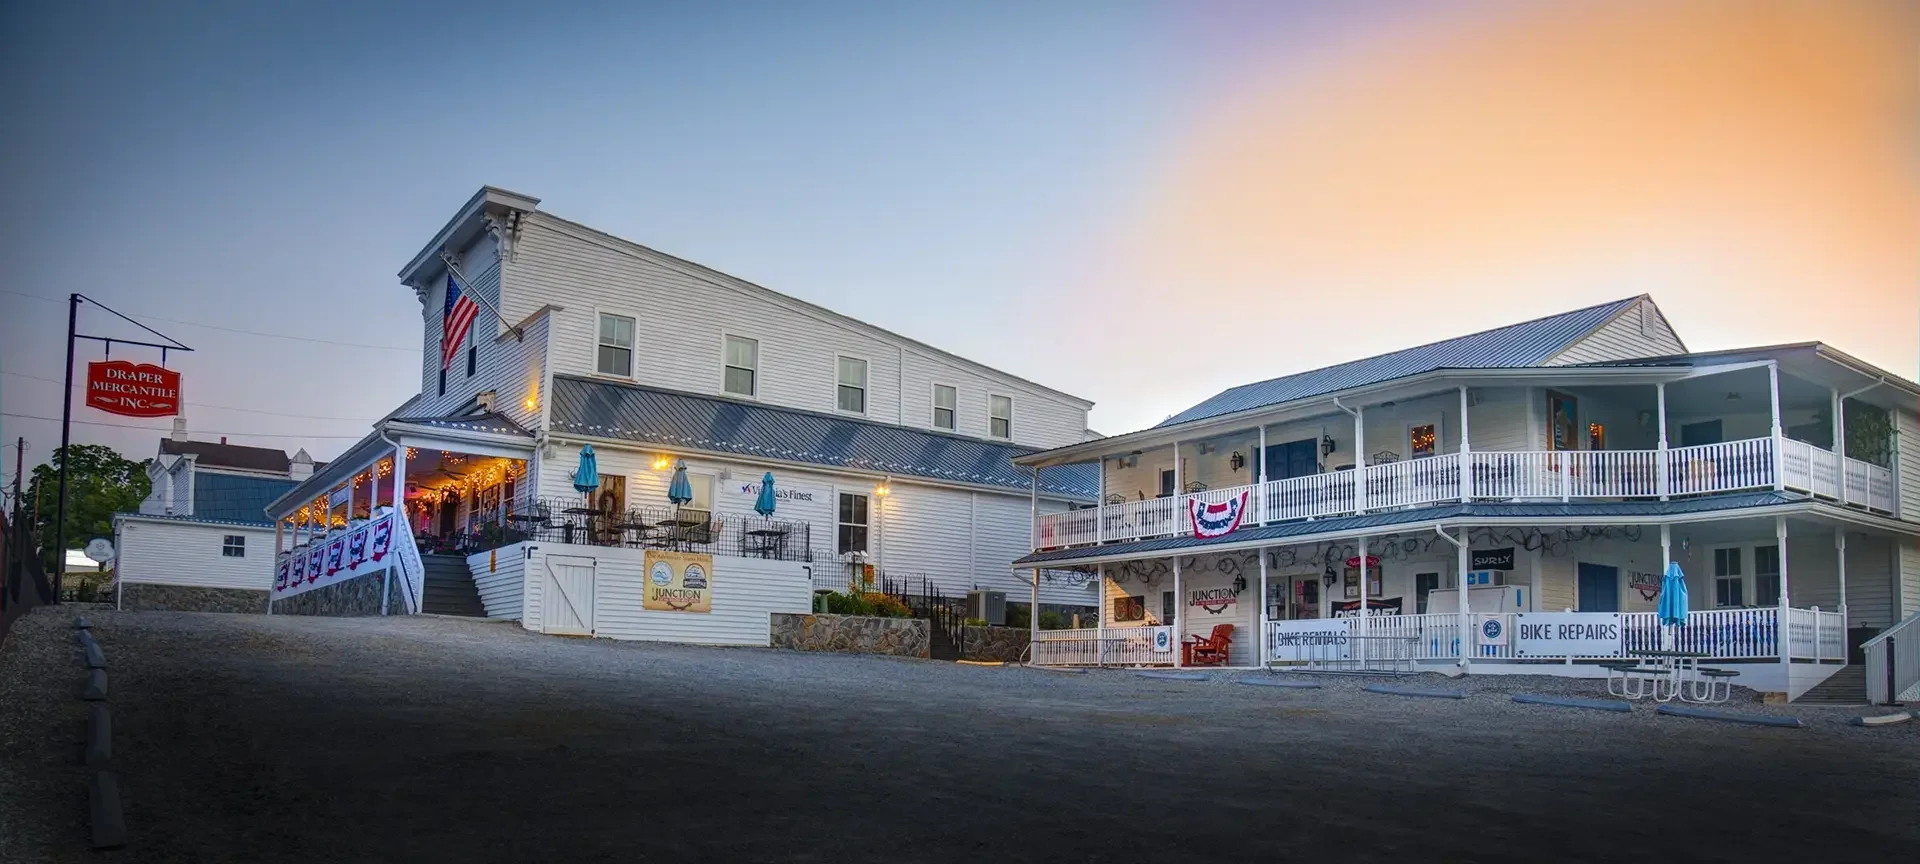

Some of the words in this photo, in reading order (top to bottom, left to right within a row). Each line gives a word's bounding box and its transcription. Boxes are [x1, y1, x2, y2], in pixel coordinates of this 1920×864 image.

[106, 368, 163, 384] DRAPER
[92, 381, 176, 398] MERCANTILE
[119, 396, 150, 409] INC.
[752, 485, 788, 499] Viia's
[789, 489, 813, 501] Finest
[1474, 554, 1511, 566] SURLY
[652, 587, 701, 601] JUNCTION
[1189, 588, 1236, 606] JUNCTION
[1278, 631, 1300, 646] BIKE
[1302, 630, 1347, 646] RENTALS
[1520, 624, 1552, 640] BIKE
[1559, 624, 1617, 640] REPAIRS
